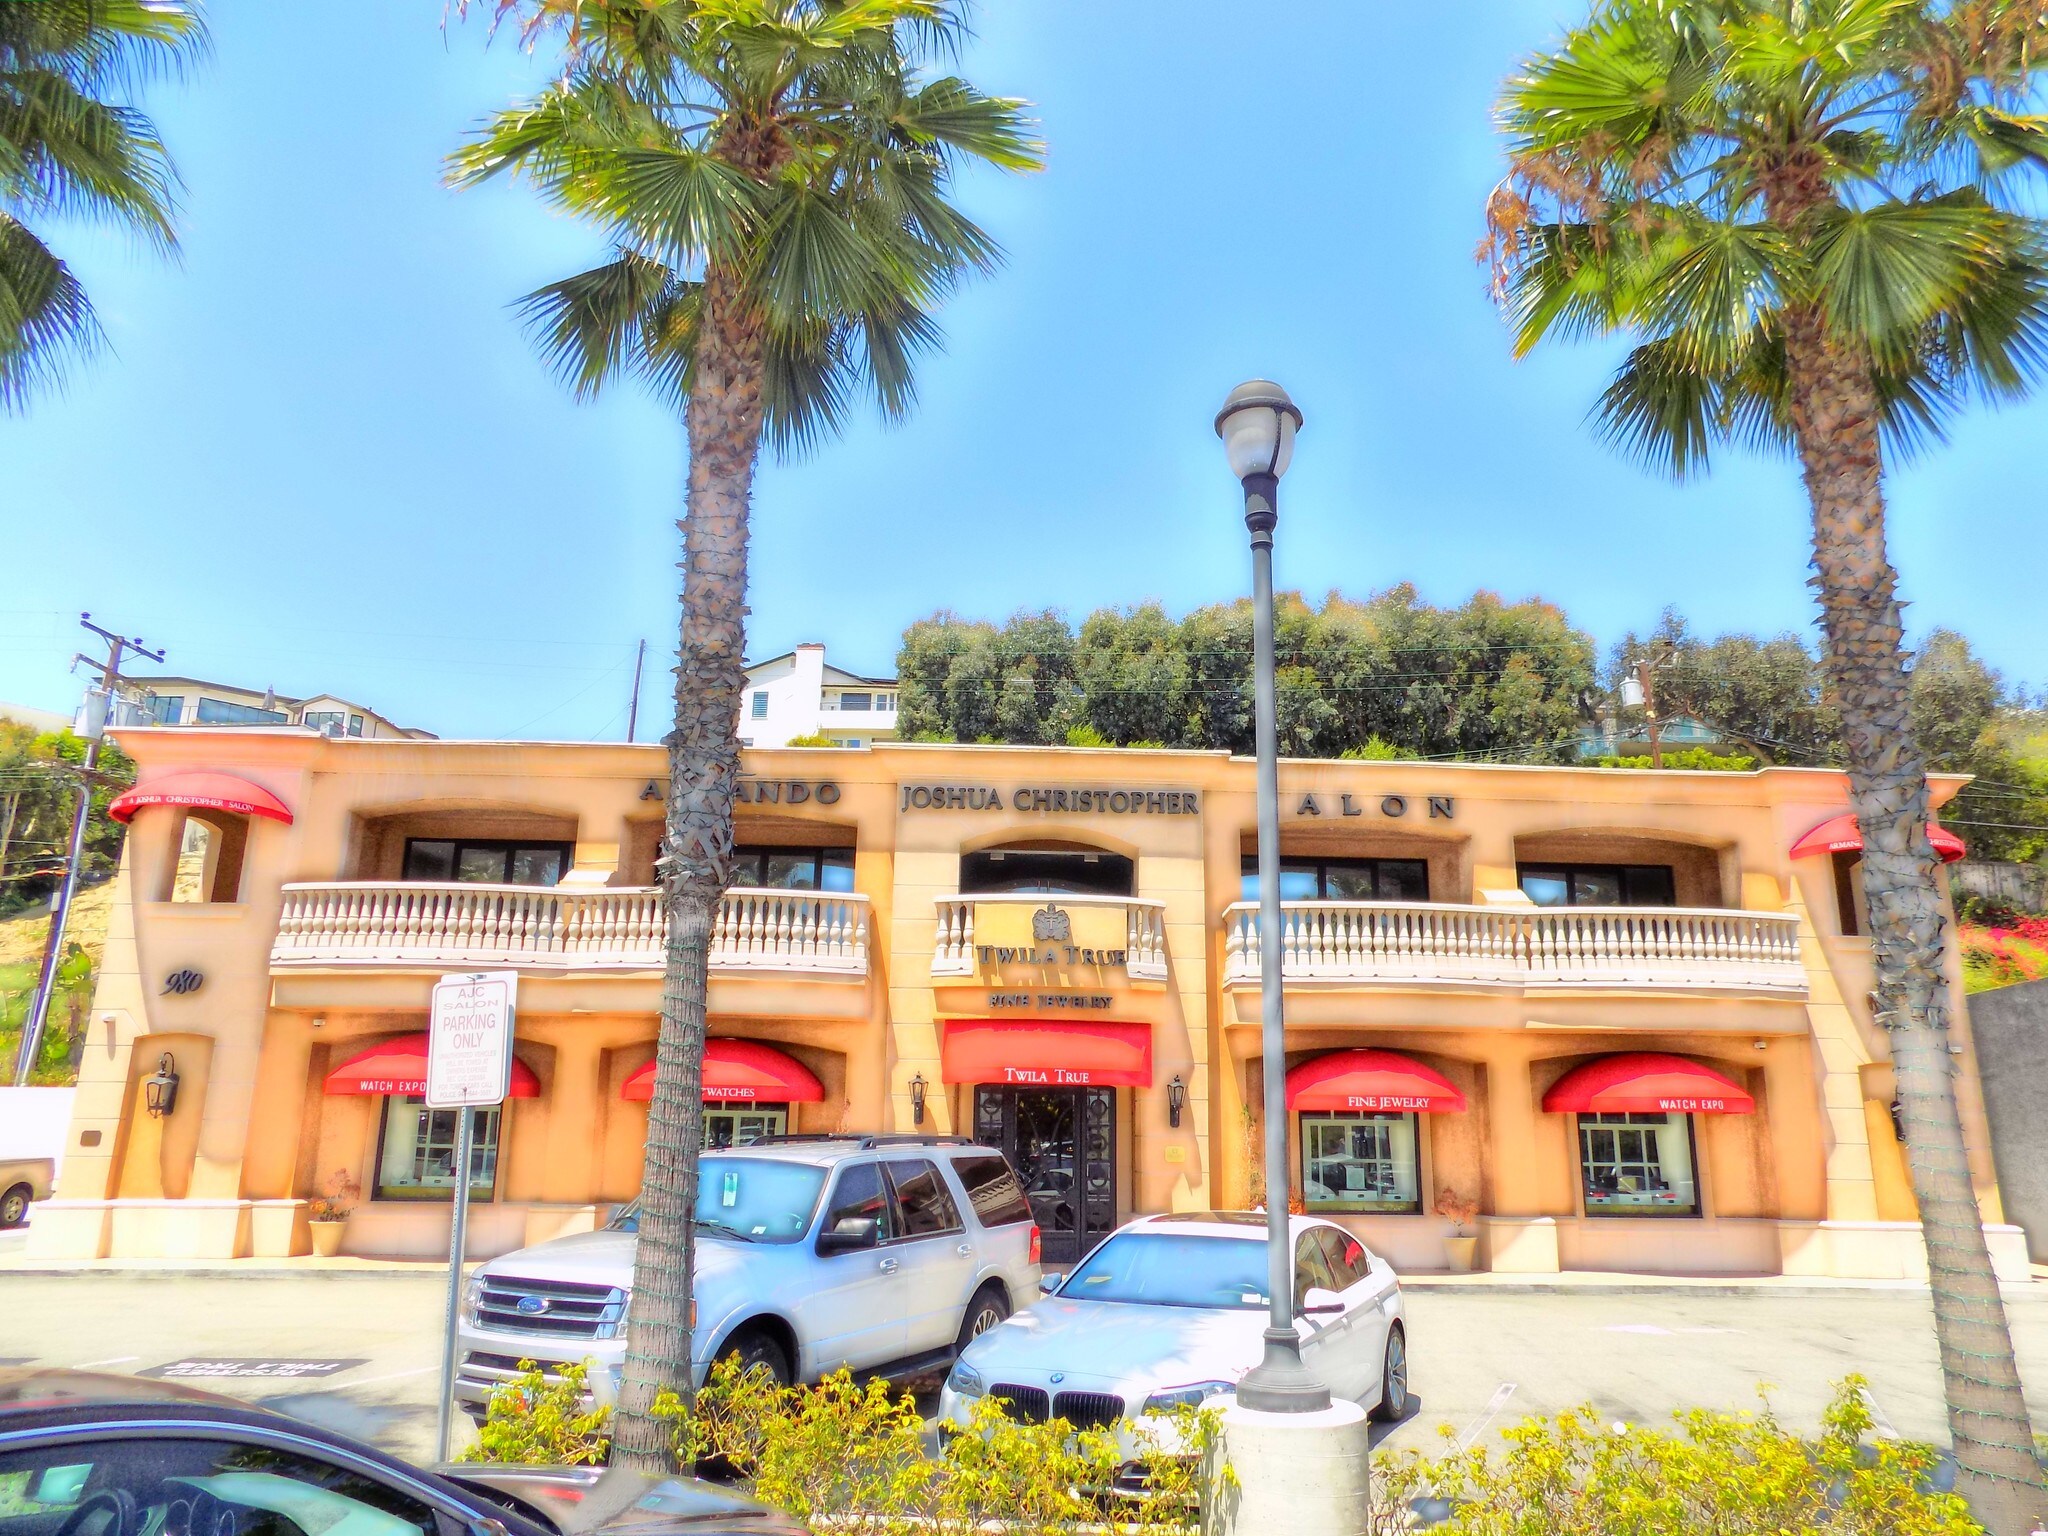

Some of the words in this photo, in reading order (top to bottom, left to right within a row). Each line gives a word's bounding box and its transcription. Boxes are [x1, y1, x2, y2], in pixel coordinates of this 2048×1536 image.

[639, 779, 841, 804] AANDO
[136, 795, 161, 805] JOSHUA
[166, 795, 224, 807] CHRISTOPHER
[228, 801, 255, 811] SALON
[901, 786, 1003, 813] JOSHUA
[1013, 789, 1199, 814] CHRISTOPHER
[1297, 793, 1455, 819] ALON
[976, 944, 1057, 965] TWILA
[1063, 945, 1126, 967] TRUE
[158, 969, 204, 996] 980
[457, 986, 485, 999] AJC
[444, 999, 498, 1010] SALON
[989, 993, 1029, 1008] FINE
[1038, 994, 1113, 1010] JEWELRY
[443, 1013, 496, 1032] PARKING
[453, 1031, 484, 1049] ONLY
[1004, 1067, 1048, 1082] TWILA
[1054, 1068, 1090, 1083] TRUE
[360, 1080, 393, 1091] WATCH
[398, 1081, 426, 1092] EXPO
[707, 1087, 755, 1097] WATCHES
[1348, 1096, 1377, 1107] FINE
[1379, 1097, 1429, 1110] JEWELRY
[1659, 1099, 1697, 1110] WATCH
[1701, 1099, 1724, 1110] EXPO
